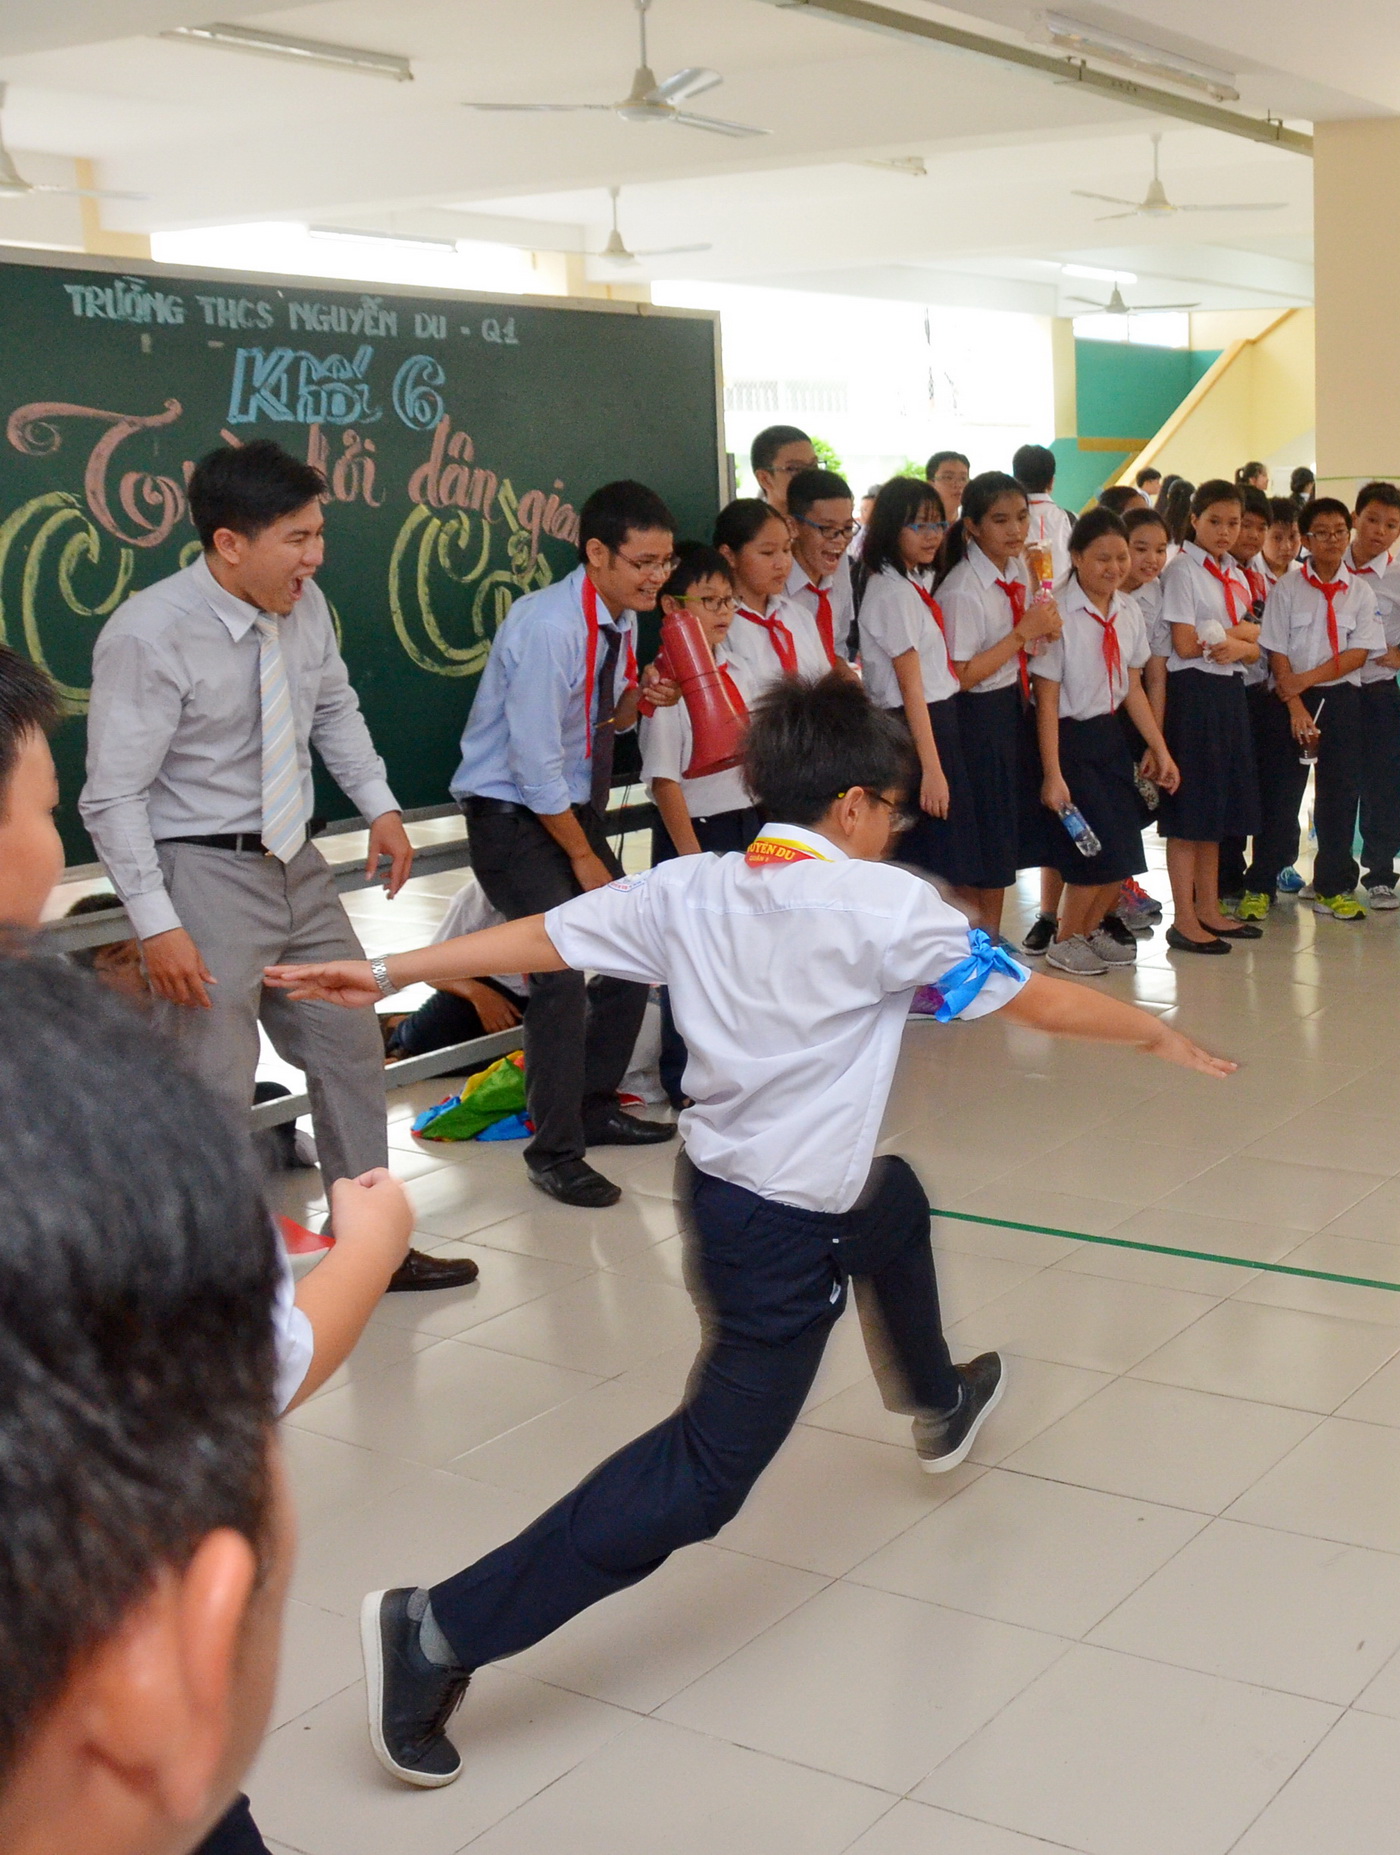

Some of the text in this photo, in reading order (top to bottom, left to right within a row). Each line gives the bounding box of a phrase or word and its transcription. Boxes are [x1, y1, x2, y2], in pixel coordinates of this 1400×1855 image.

[195, 294, 274, 330] THCS
[414, 312, 447, 340] DU
[481, 317, 519, 345] Q1
[392, 354, 446, 431] 6
[775, 847, 796, 860] DU
